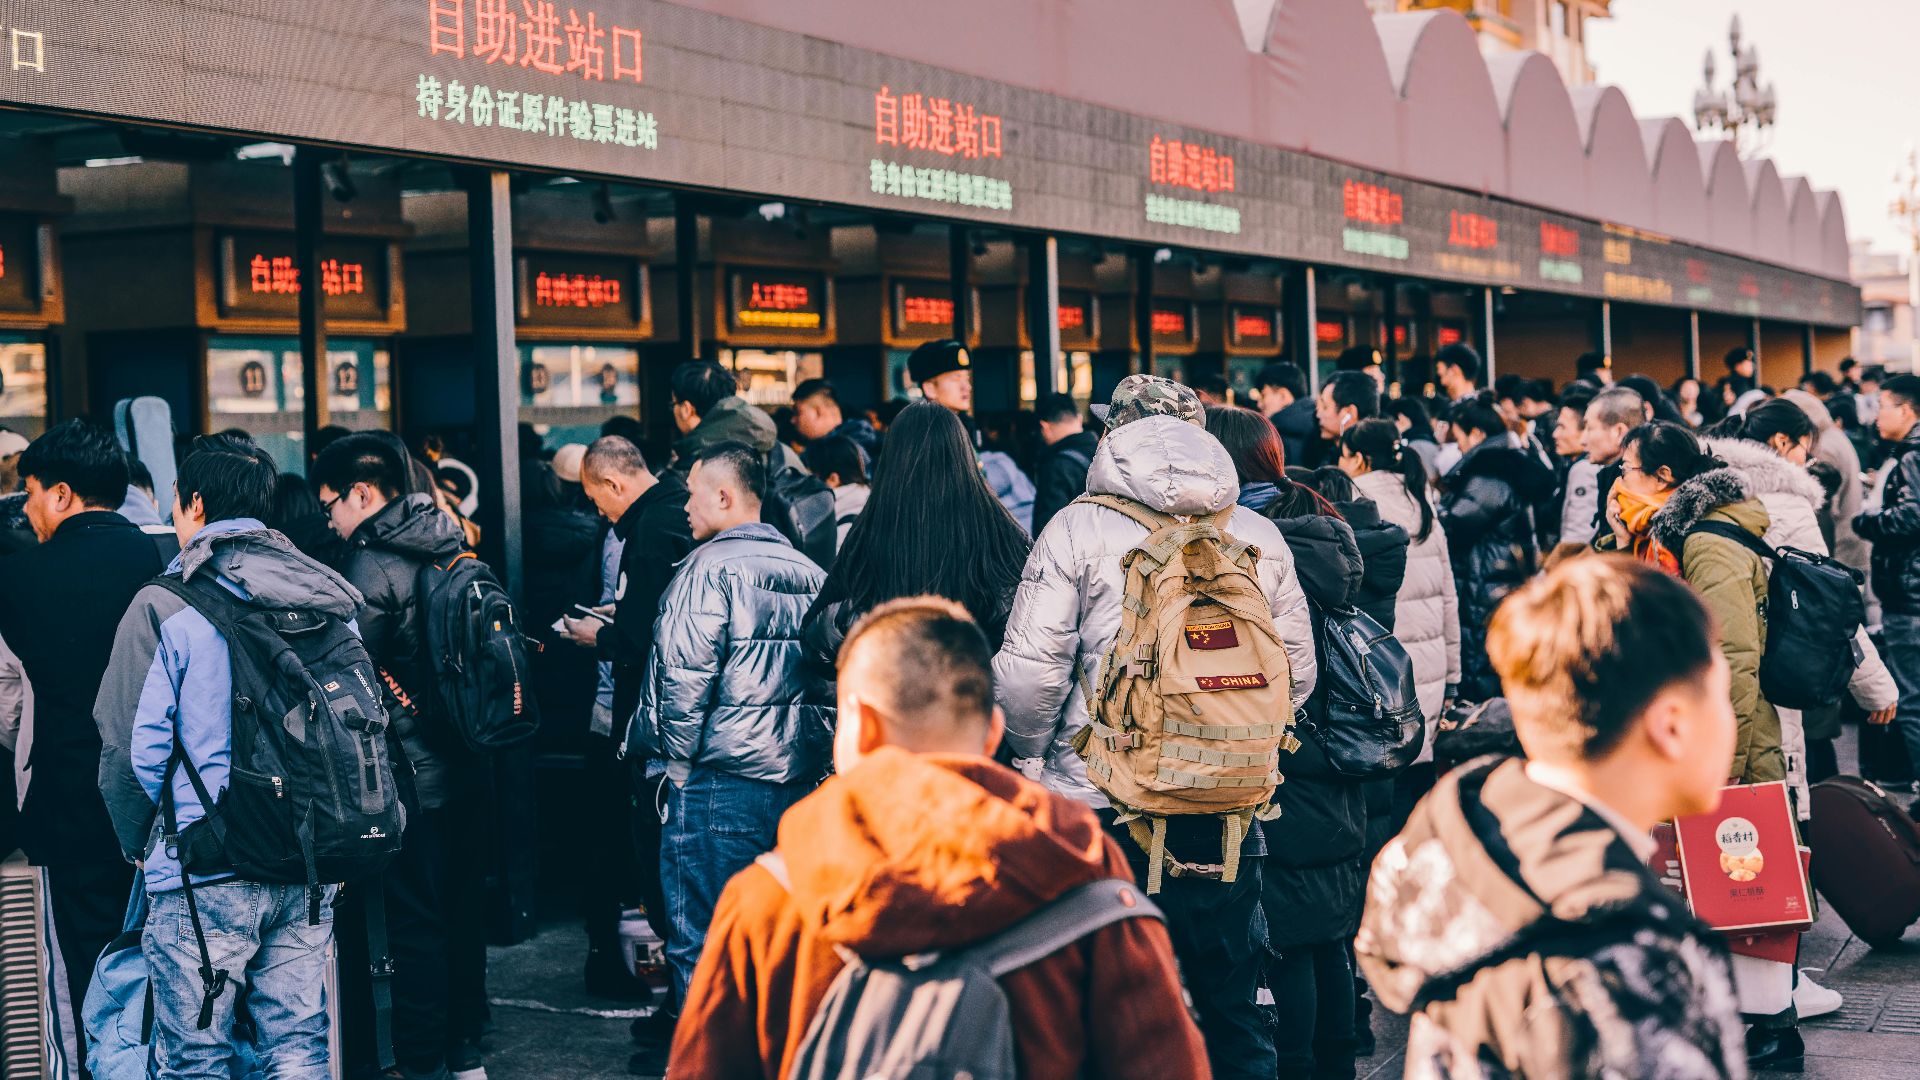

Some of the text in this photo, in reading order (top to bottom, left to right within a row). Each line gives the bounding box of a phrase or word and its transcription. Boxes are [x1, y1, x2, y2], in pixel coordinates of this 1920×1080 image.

[428, 0, 643, 83] 自助进站口
[416, 73, 658, 150] 持身份证原件验票进站
[874, 84, 1003, 159] 自助进站口
[1220, 676, 1261, 686] CHINA
[1722, 831, 1753, 843] 稻香村
